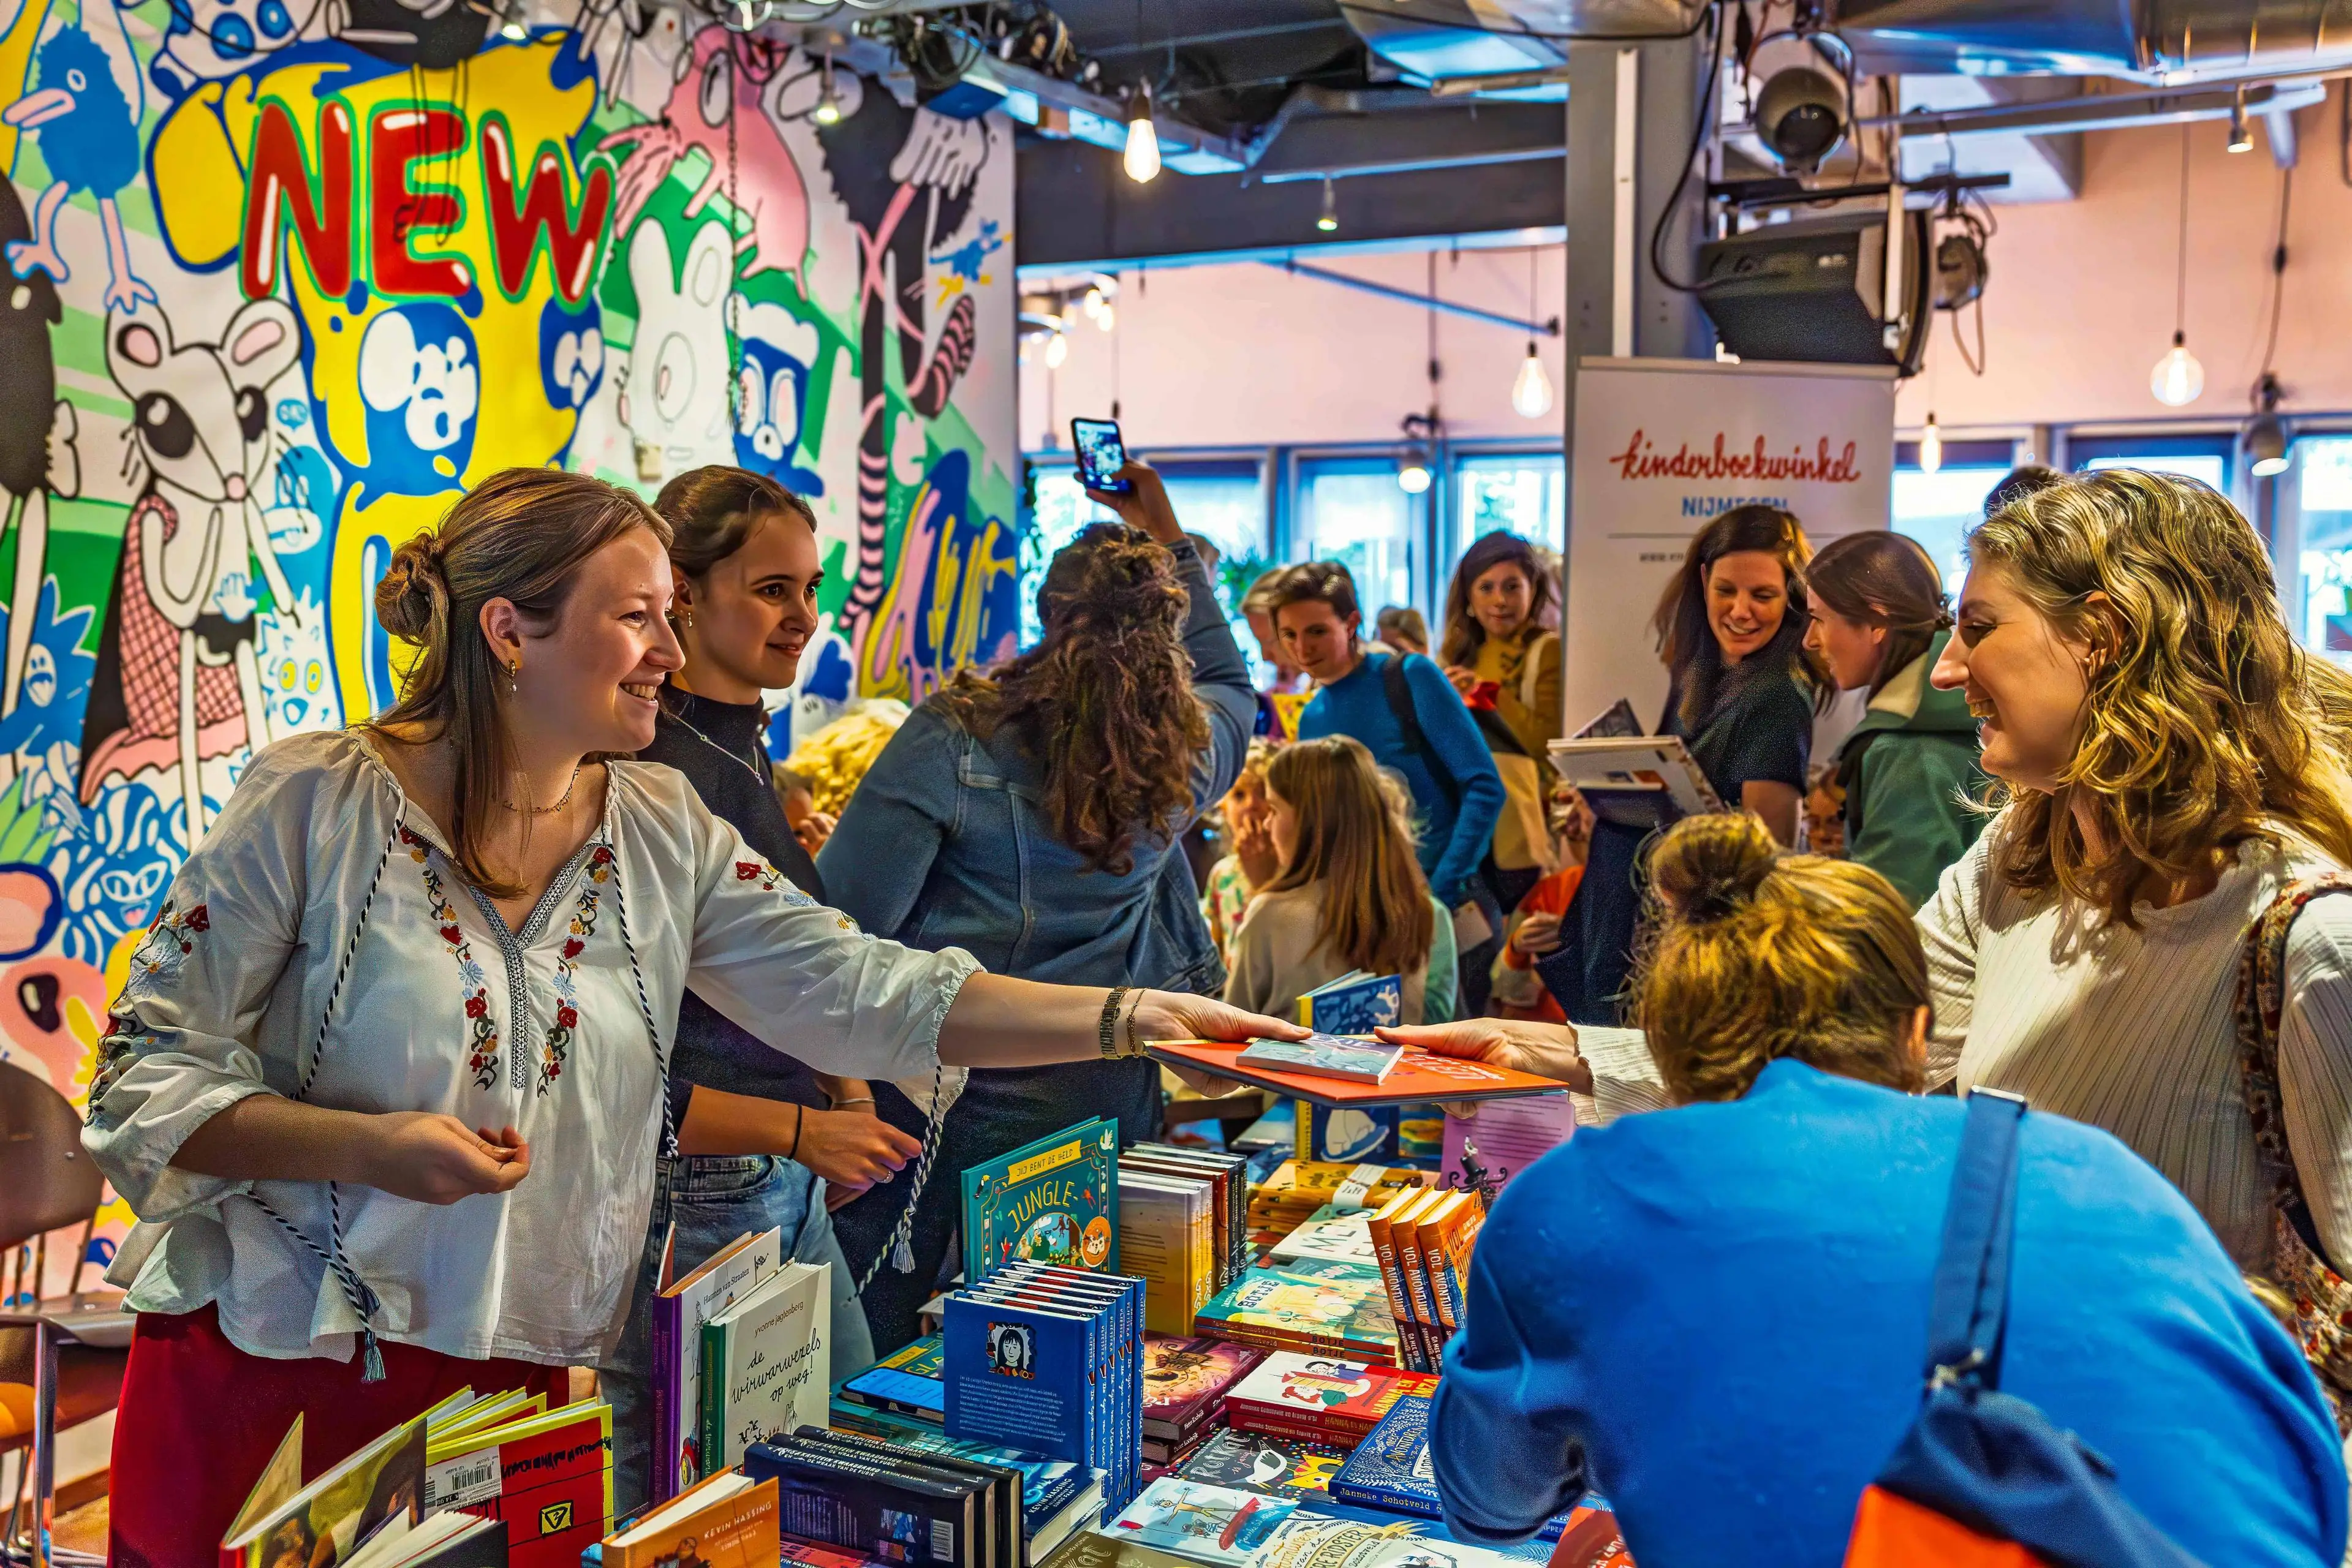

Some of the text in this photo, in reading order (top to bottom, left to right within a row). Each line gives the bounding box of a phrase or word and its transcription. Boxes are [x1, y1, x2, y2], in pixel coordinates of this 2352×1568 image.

[241, 95, 615, 311] NEW
[1609, 428, 1861, 483] kinderboekwinkel
[1016, 1148, 1073, 1176] JIJ BENT DE HELD
[1007, 1180, 1077, 1233] JUNGLE
[1448, 1225, 1464, 1257] VOL
[1237, 1280, 1280, 1308] BOTJE
[1379, 1243, 1405, 1315] VOL AVONTUUR
[1403, 1246, 1429, 1317] VOL AVONTUUR
[1428, 1248, 1453, 1319] VOL AVONTUUR
[704, 1288, 722, 1305] Harmen
[754, 1319, 774, 1338] yvonne
[1312, 1335, 1345, 1346] BOTJE
[732, 1327, 821, 1404] wirwarwezels
[747, 1351, 765, 1370] de
[1313, 1348, 1345, 1358] BOTJE
[770, 1355, 813, 1401] op weg!
[1371, 1389, 1411, 1414] HANNA
[1386, 1426, 1427, 1461] AVONTUREN
[1410, 1444, 1423, 1459] van
[1029, 1478, 1072, 1513] KEVIN HASSING
[1340, 1488, 1377, 1501] Janneke
[1383, 1495, 1431, 1510] Schotveld
[705, 1522, 731, 1539] KEVIN
[734, 1501, 771, 1526] HASSING
[1312, 1538, 1325, 1547] de
[1323, 1529, 1372, 1564] RIDSTER
